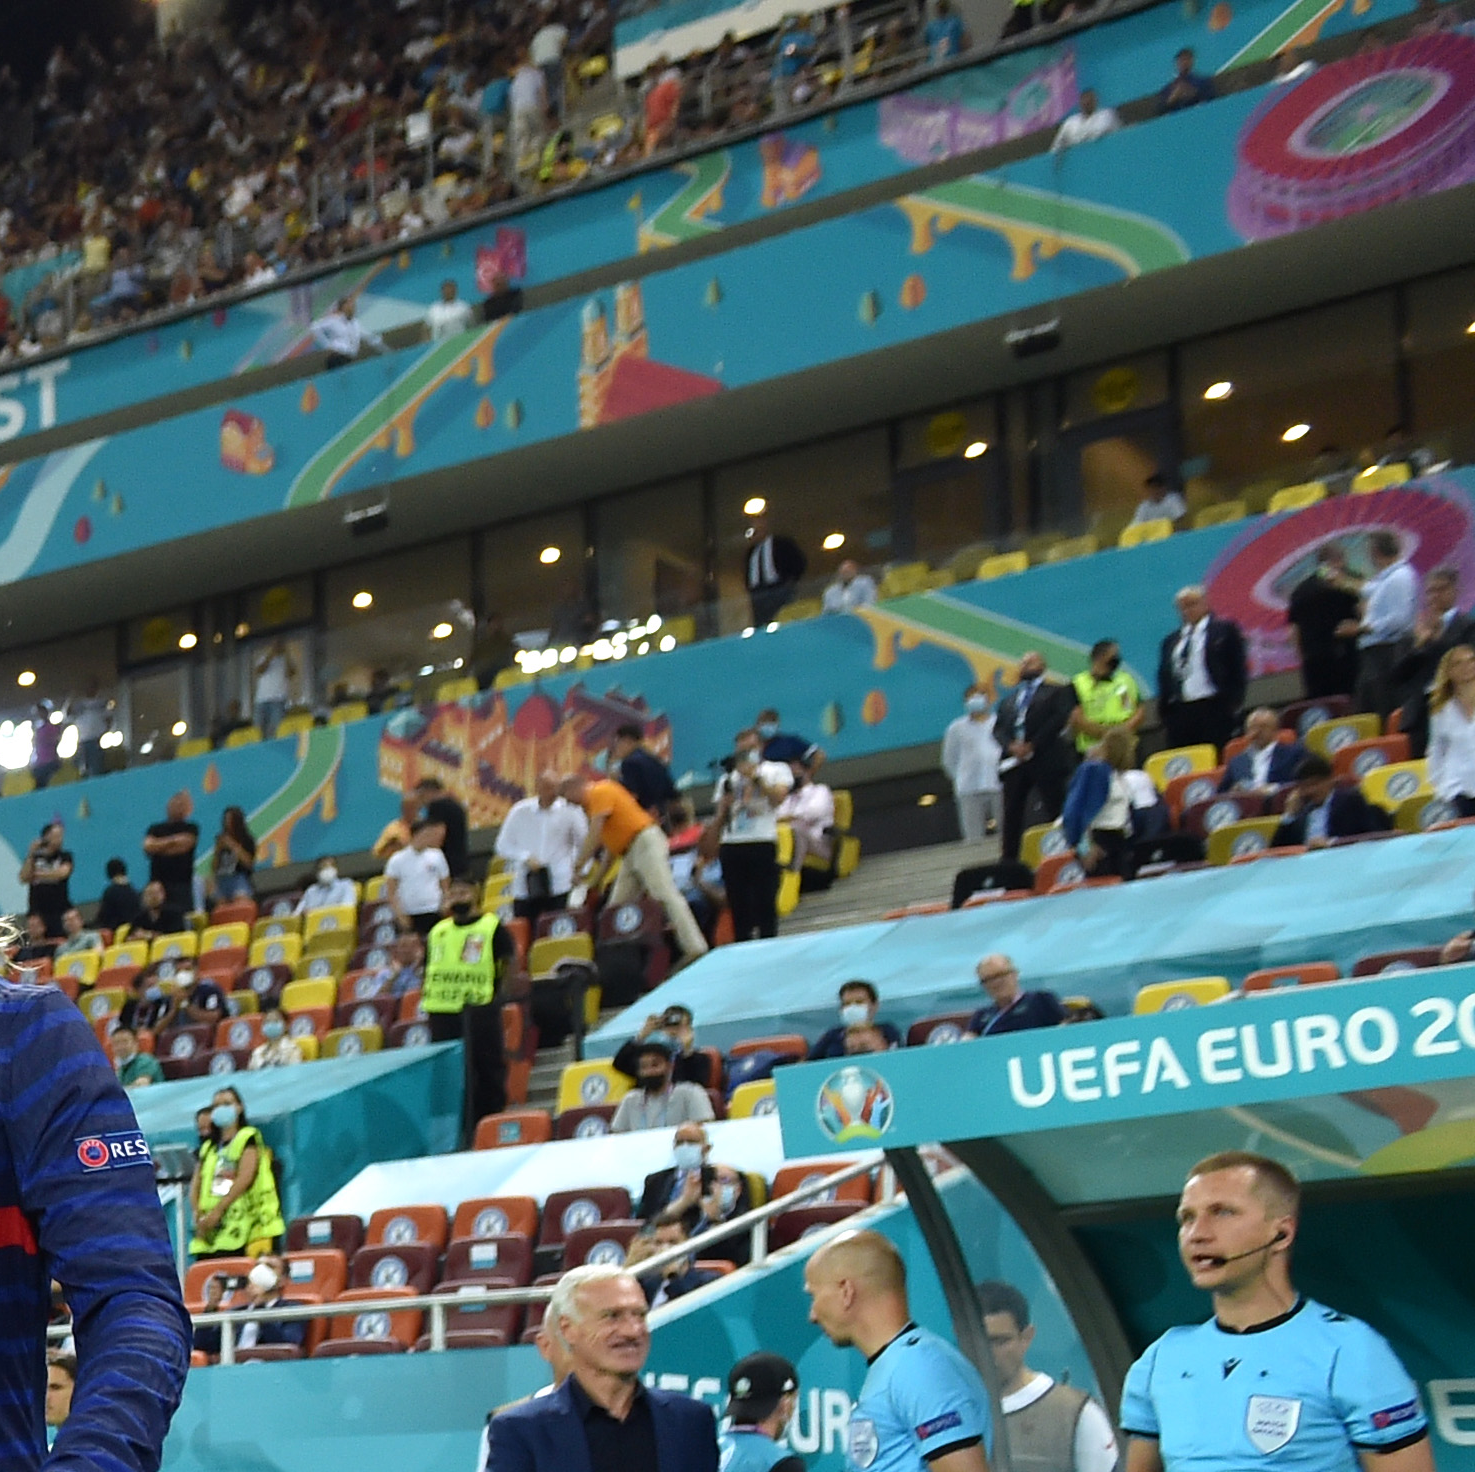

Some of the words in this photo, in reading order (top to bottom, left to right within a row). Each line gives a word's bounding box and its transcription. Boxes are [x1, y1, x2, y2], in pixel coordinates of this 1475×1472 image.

[1007, 1036, 1191, 1108] UEFA
[1197, 1006, 1400, 1085] EURO
[110, 1138, 150, 1159] RES
